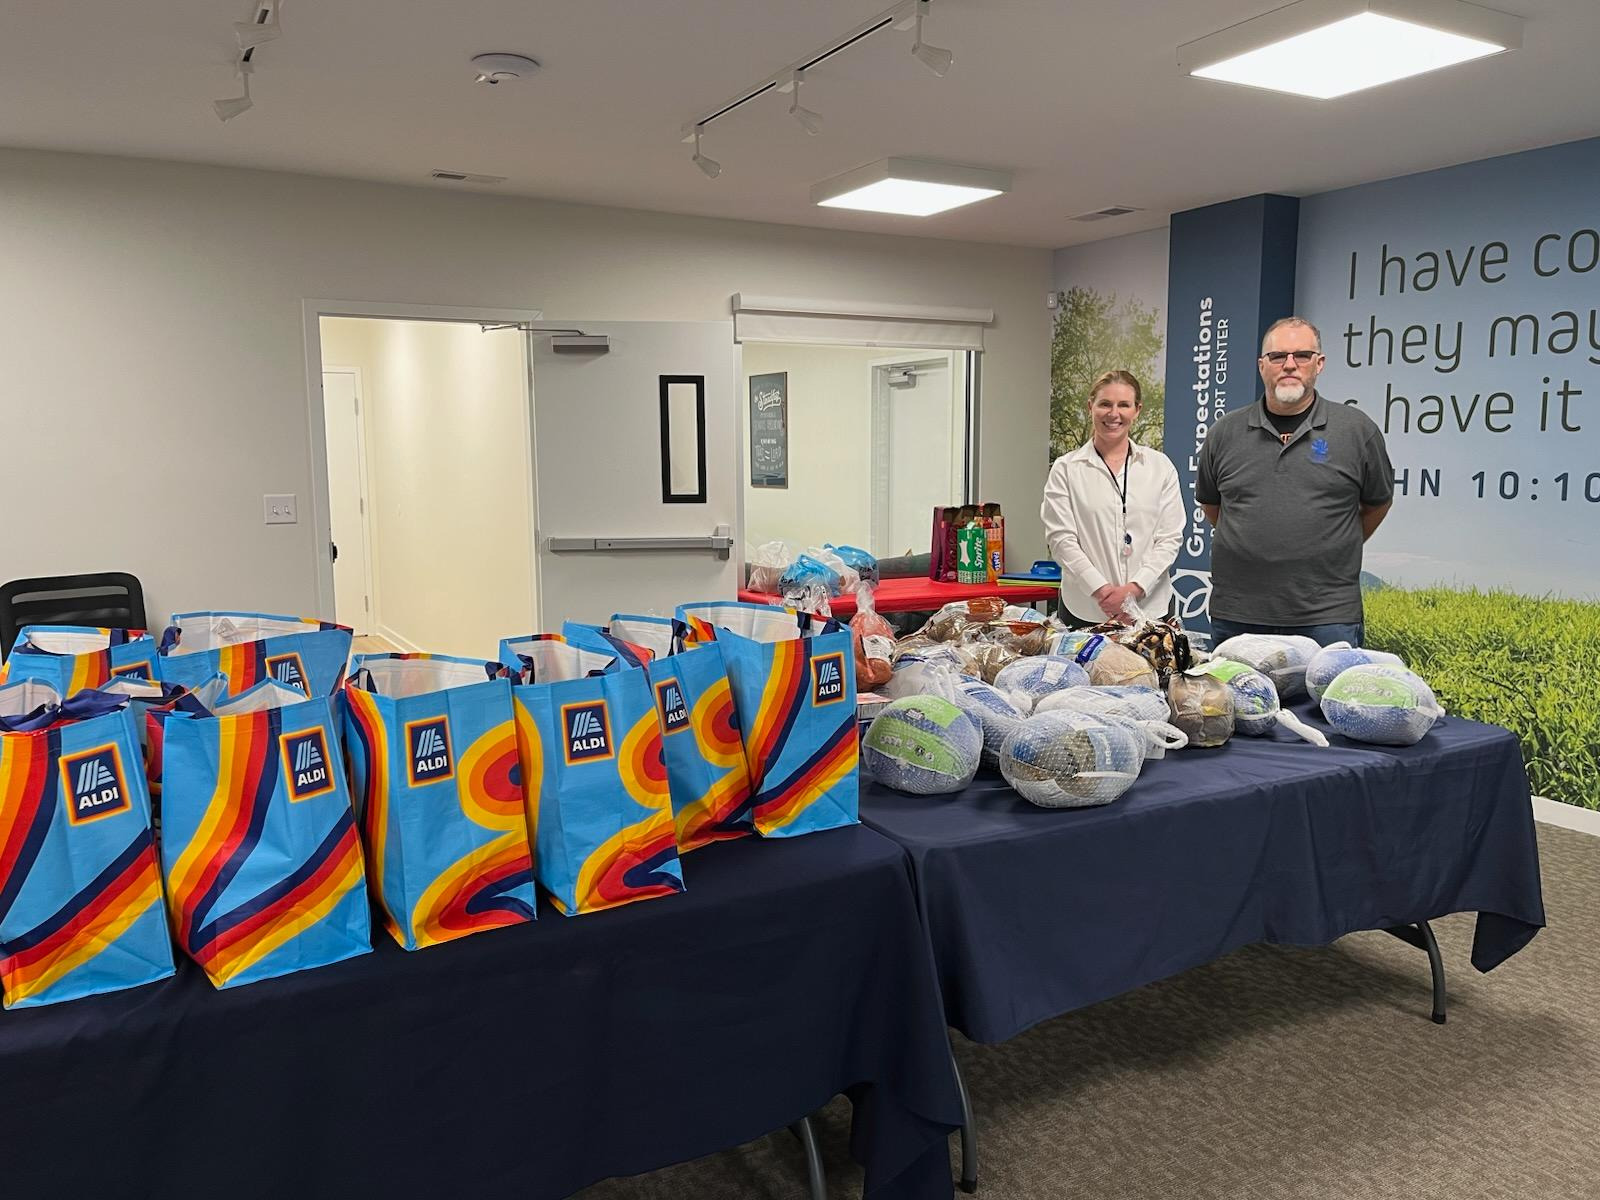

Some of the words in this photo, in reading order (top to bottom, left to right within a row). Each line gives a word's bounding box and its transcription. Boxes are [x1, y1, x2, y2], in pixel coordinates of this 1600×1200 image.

[1349, 251, 1358, 300] I
[1379, 243, 1509, 296] have
[1533, 228, 1600, 278] co
[1215, 318, 1229, 384] CENTER
[1343, 315, 1463, 374] they
[1189, 297, 1213, 472] Expectations
[1384, 383, 1514, 434] have
[1540, 376, 1583, 432] it
[1392, 468, 1441, 497] HN
[1471, 471, 1600, 503] 10:10
[974, 537, 984, 568] Sprite
[819, 682, 841, 696] ALDI
[667, 708, 688, 724] ALDI
[572, 737, 606, 752] ALDI
[297, 767, 326, 787] ALDI
[416, 755, 448, 773] ALDI
[79, 786, 119, 810] ALDI
